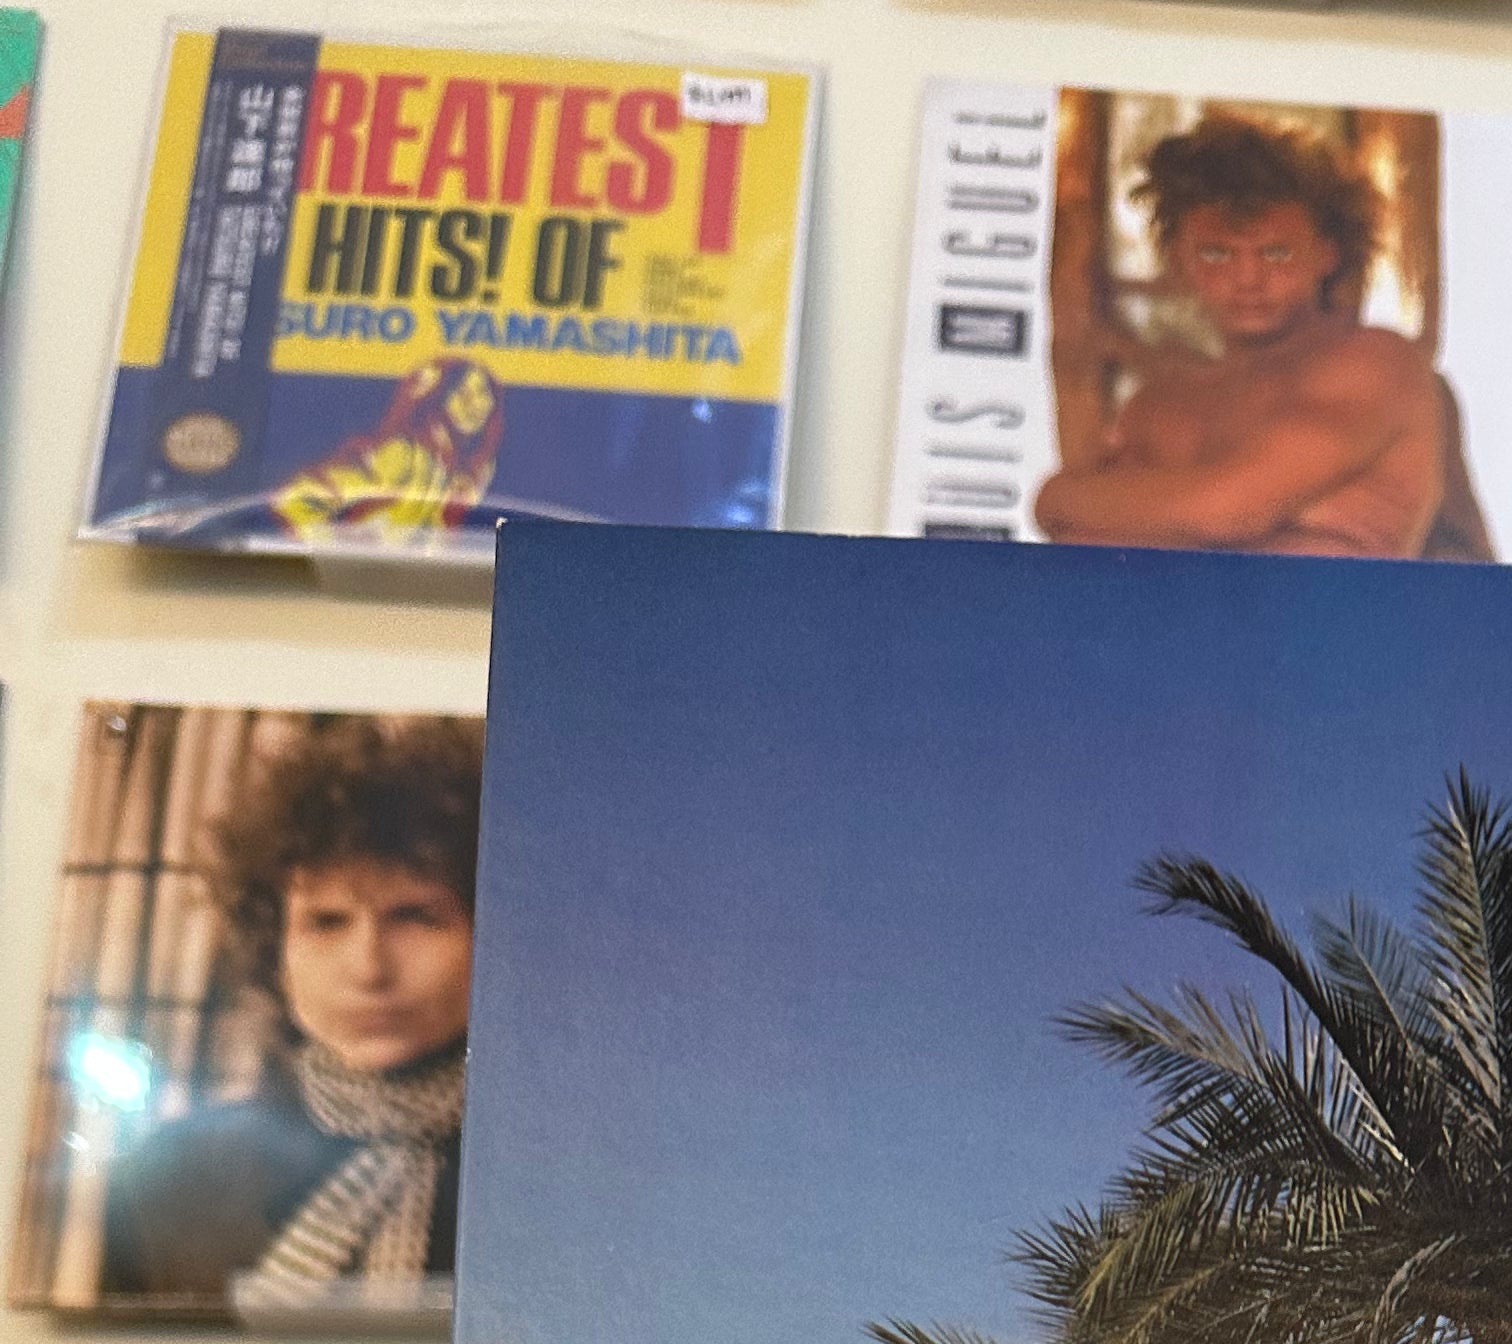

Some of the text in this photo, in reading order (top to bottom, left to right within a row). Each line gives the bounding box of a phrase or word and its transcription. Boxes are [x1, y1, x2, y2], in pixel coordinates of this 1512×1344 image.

[306, 203, 512, 306] HITS!
[532, 214, 626, 313] OF
[437, 308, 744, 367] YAMASHITA
[923, 399, 1026, 541] UIS
